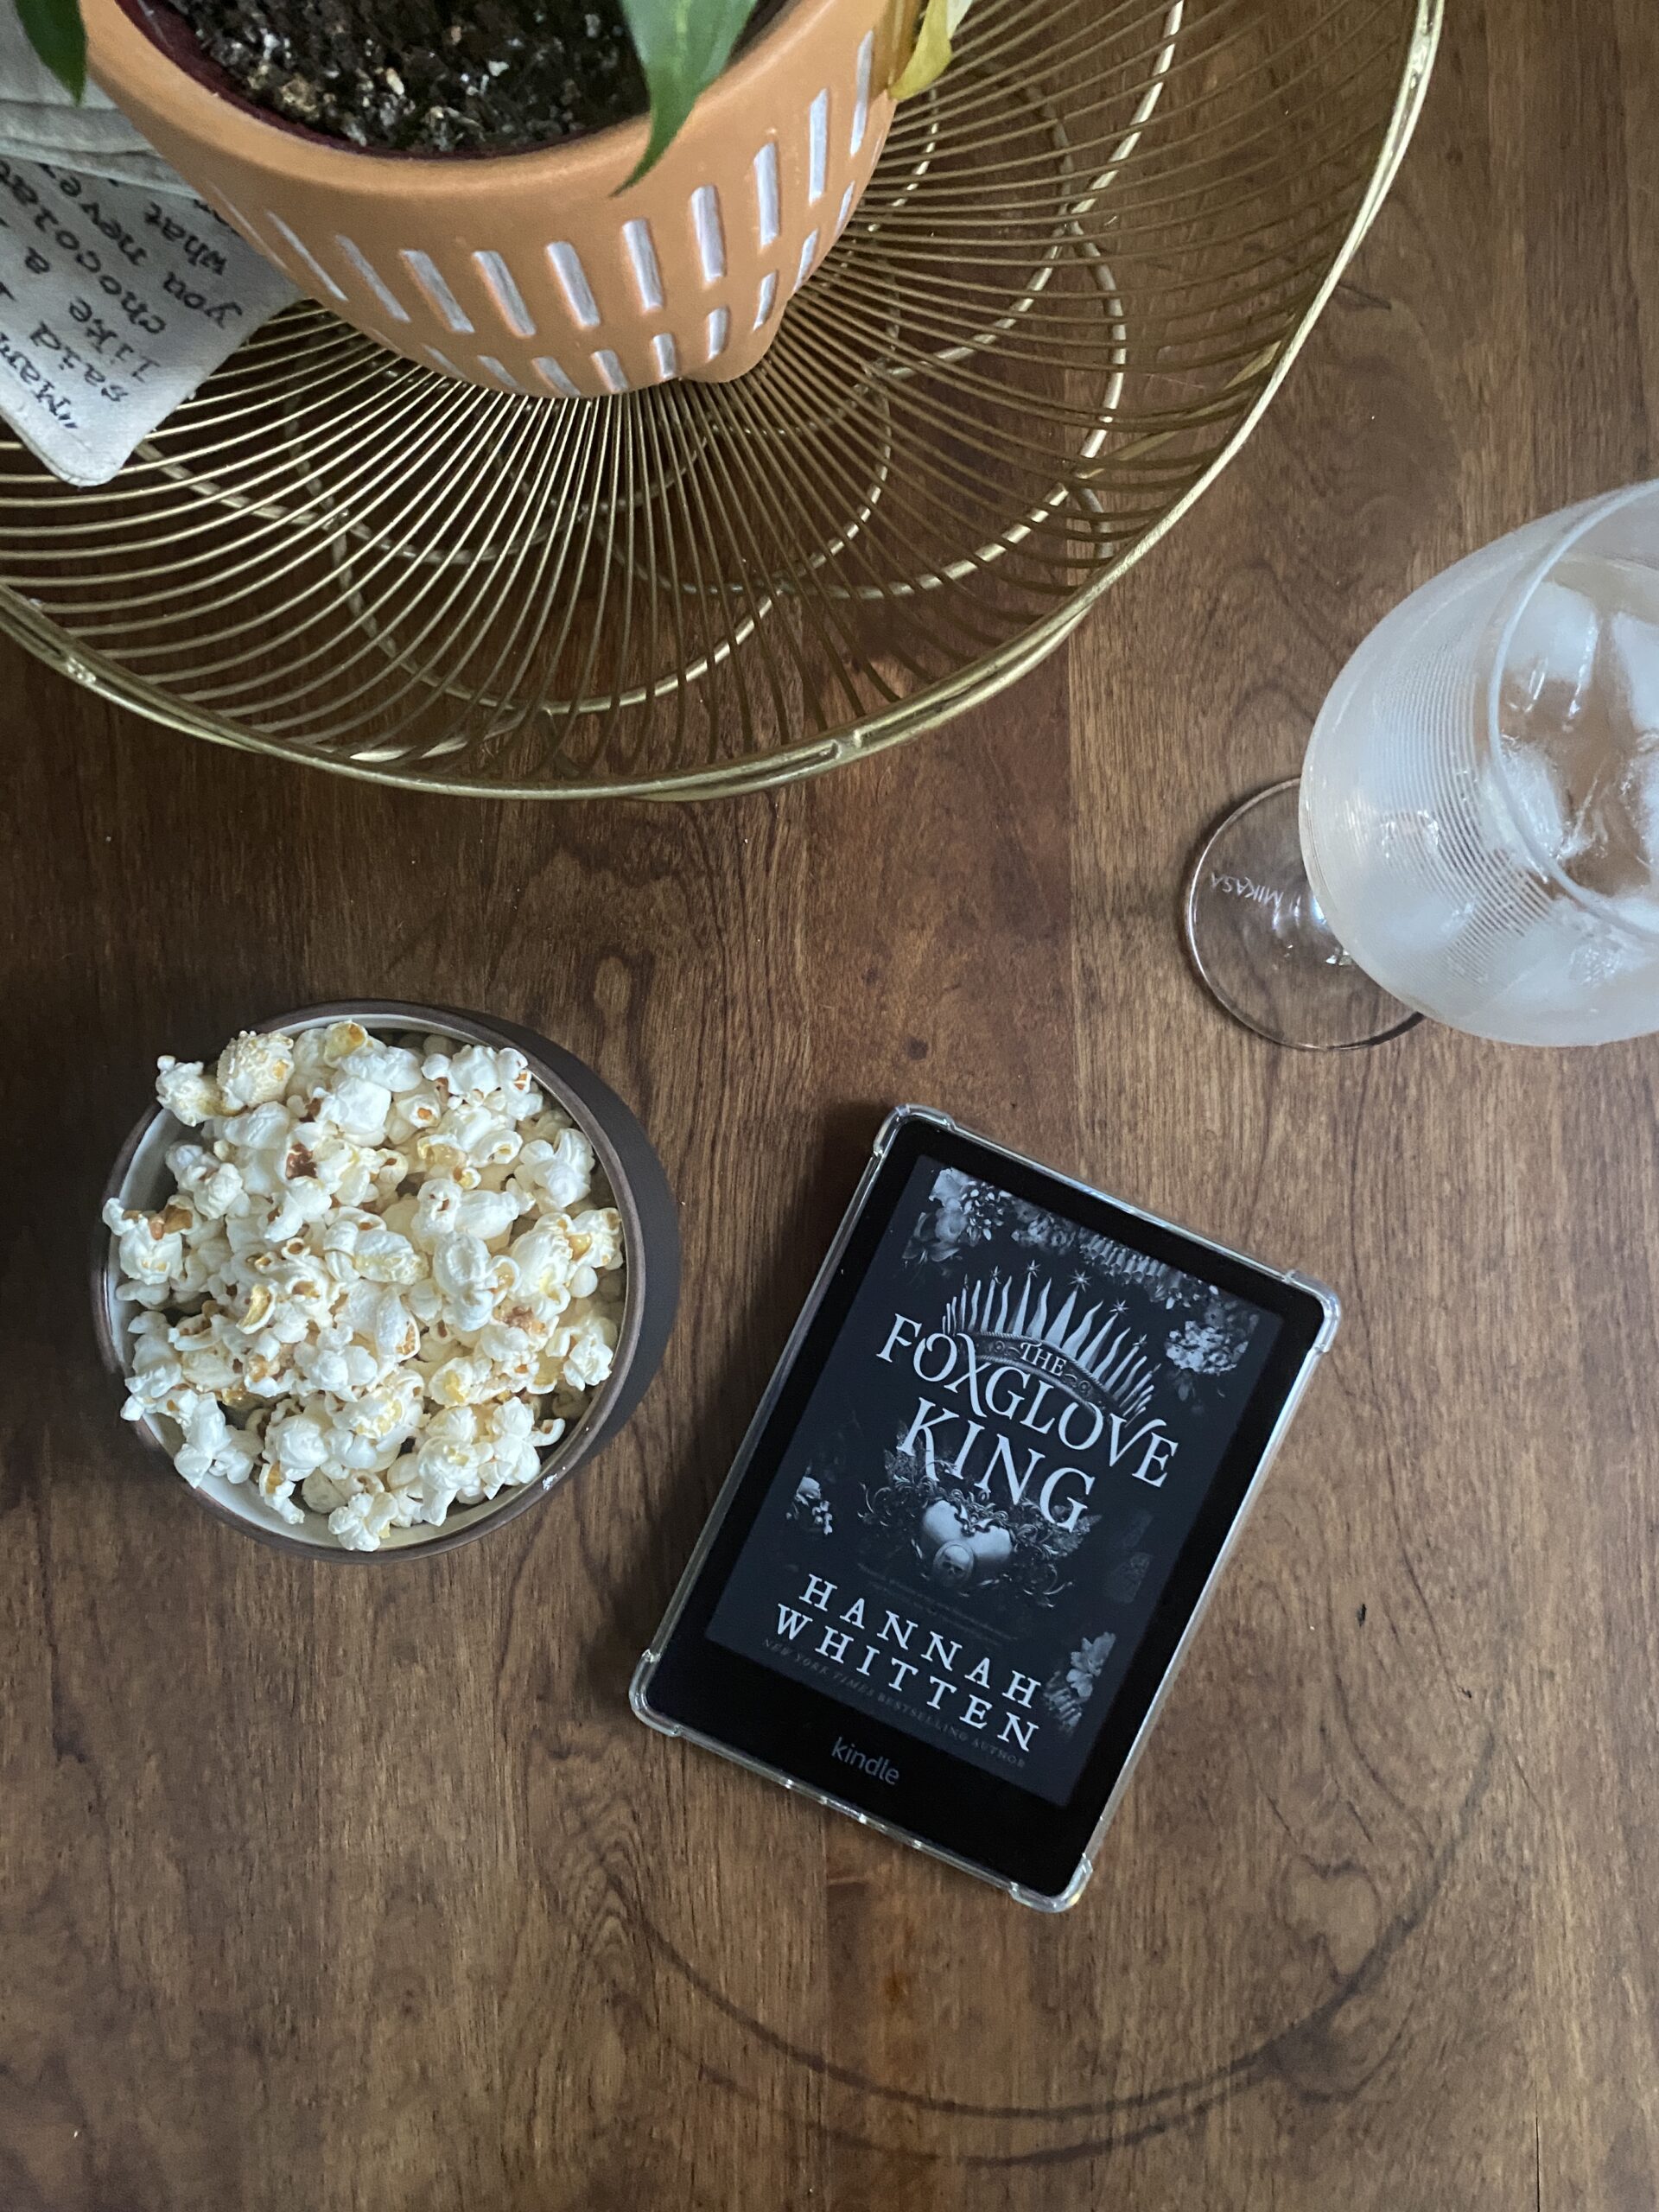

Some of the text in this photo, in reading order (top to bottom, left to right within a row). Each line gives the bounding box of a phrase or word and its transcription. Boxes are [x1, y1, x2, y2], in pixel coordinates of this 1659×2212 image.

[143, 201, 228, 276] what
[24, 247, 161, 382] like a
[162, 270, 243, 328] you
[29, 321, 129, 403] said
[1211, 871, 1284, 905] MIKASA
[876, 1313, 1179, 1488] FOXGLOVE
[1020, 1341, 1067, 1377] THE
[896, 1396, 1096, 1533] KING
[777, 1602, 1040, 1753] WHITTEN
[798, 1573, 1042, 1709] HANNAH
[762, 1638, 1026, 1769] NEW YORK TIMES BESTSELLING AUTHOR
[831, 1737, 900, 1786] kindle
